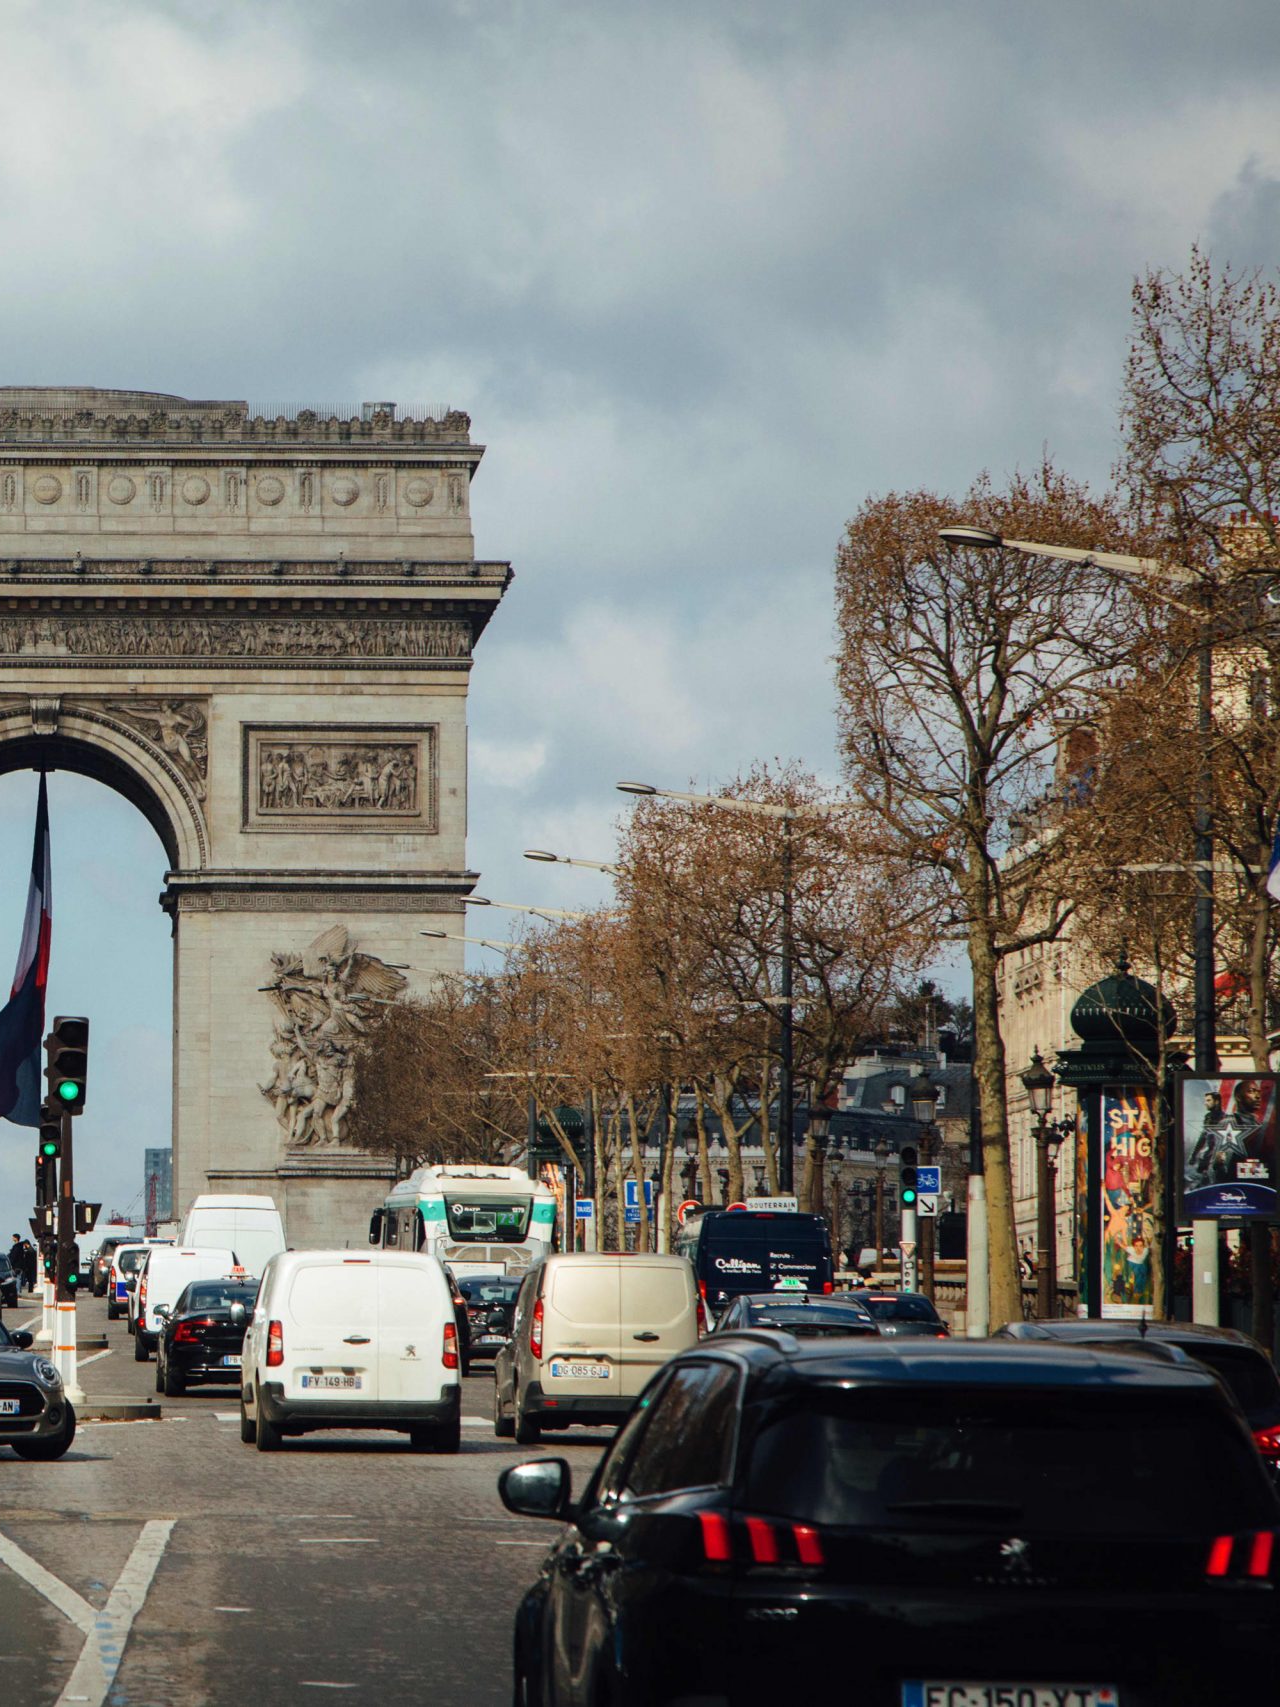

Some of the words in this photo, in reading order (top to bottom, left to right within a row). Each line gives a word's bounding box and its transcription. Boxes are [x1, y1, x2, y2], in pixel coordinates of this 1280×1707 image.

[1108, 1109, 1154, 1134] STA
[1111, 1137, 1153, 1159] HIG
[499, 1213, 515, 1224] 73
